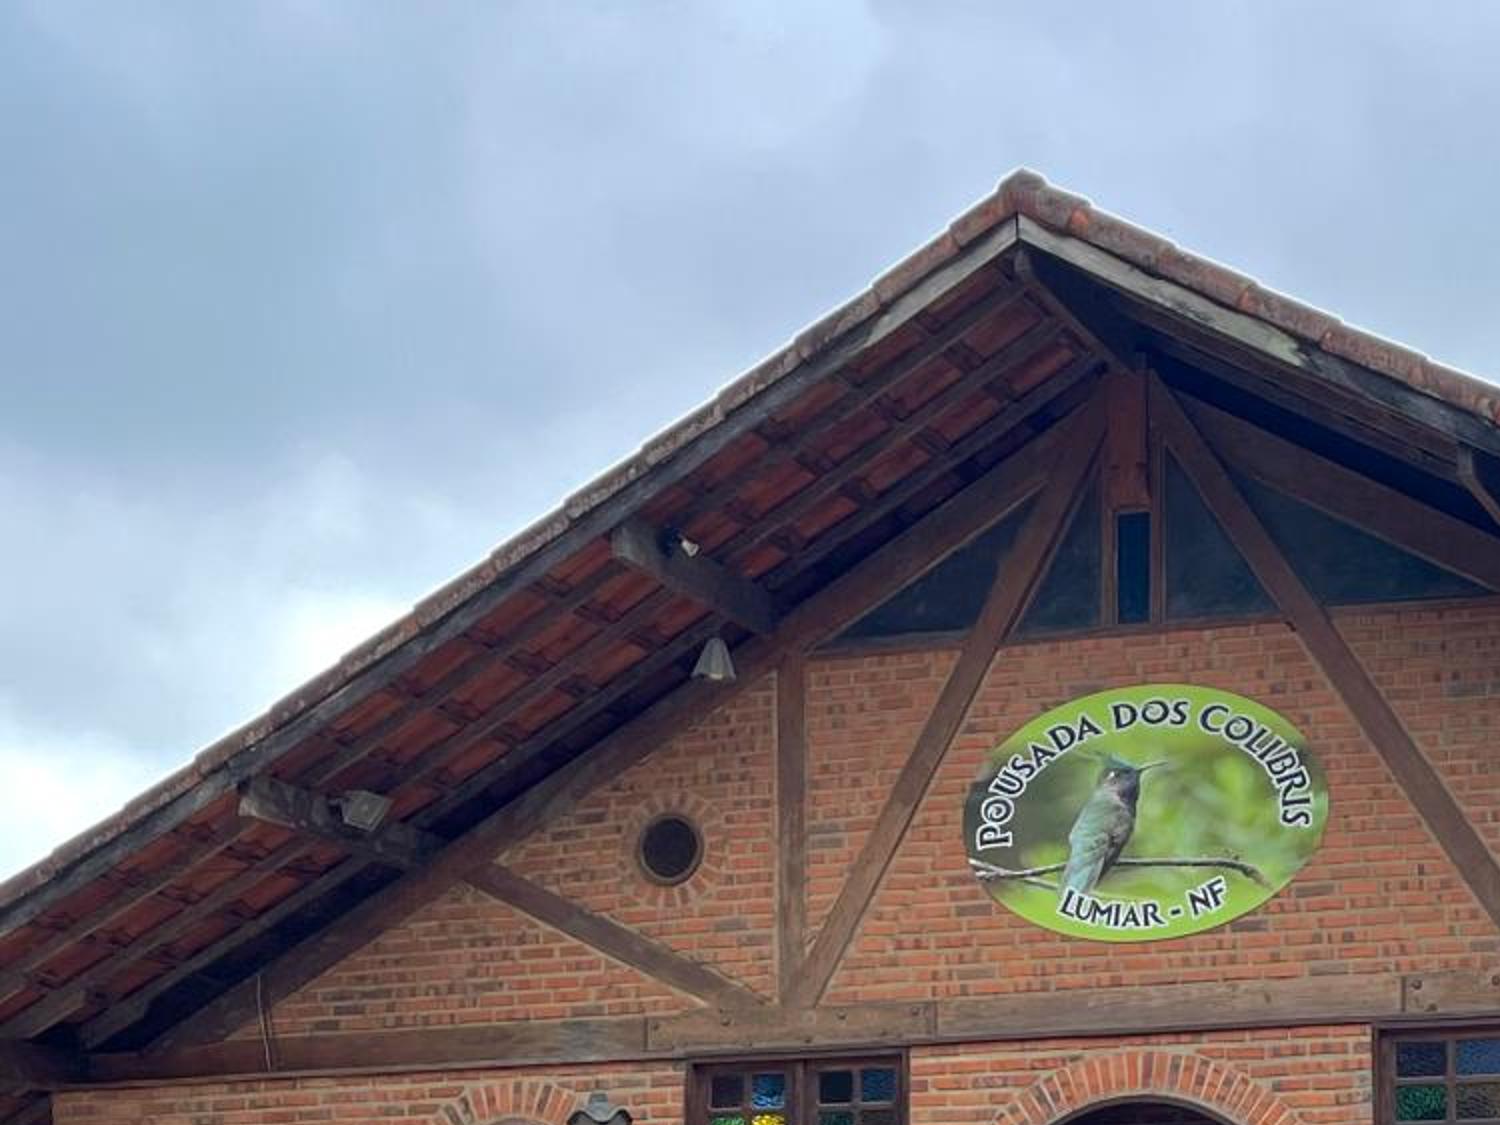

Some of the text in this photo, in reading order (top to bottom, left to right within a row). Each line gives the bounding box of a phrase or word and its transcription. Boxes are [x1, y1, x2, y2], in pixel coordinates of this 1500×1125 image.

[977, 701, 1313, 849] POUSADA DOS COLIBRIS
[1059, 890, 1166, 928] LUMIAR
[1187, 877, 1228, 916] NF
